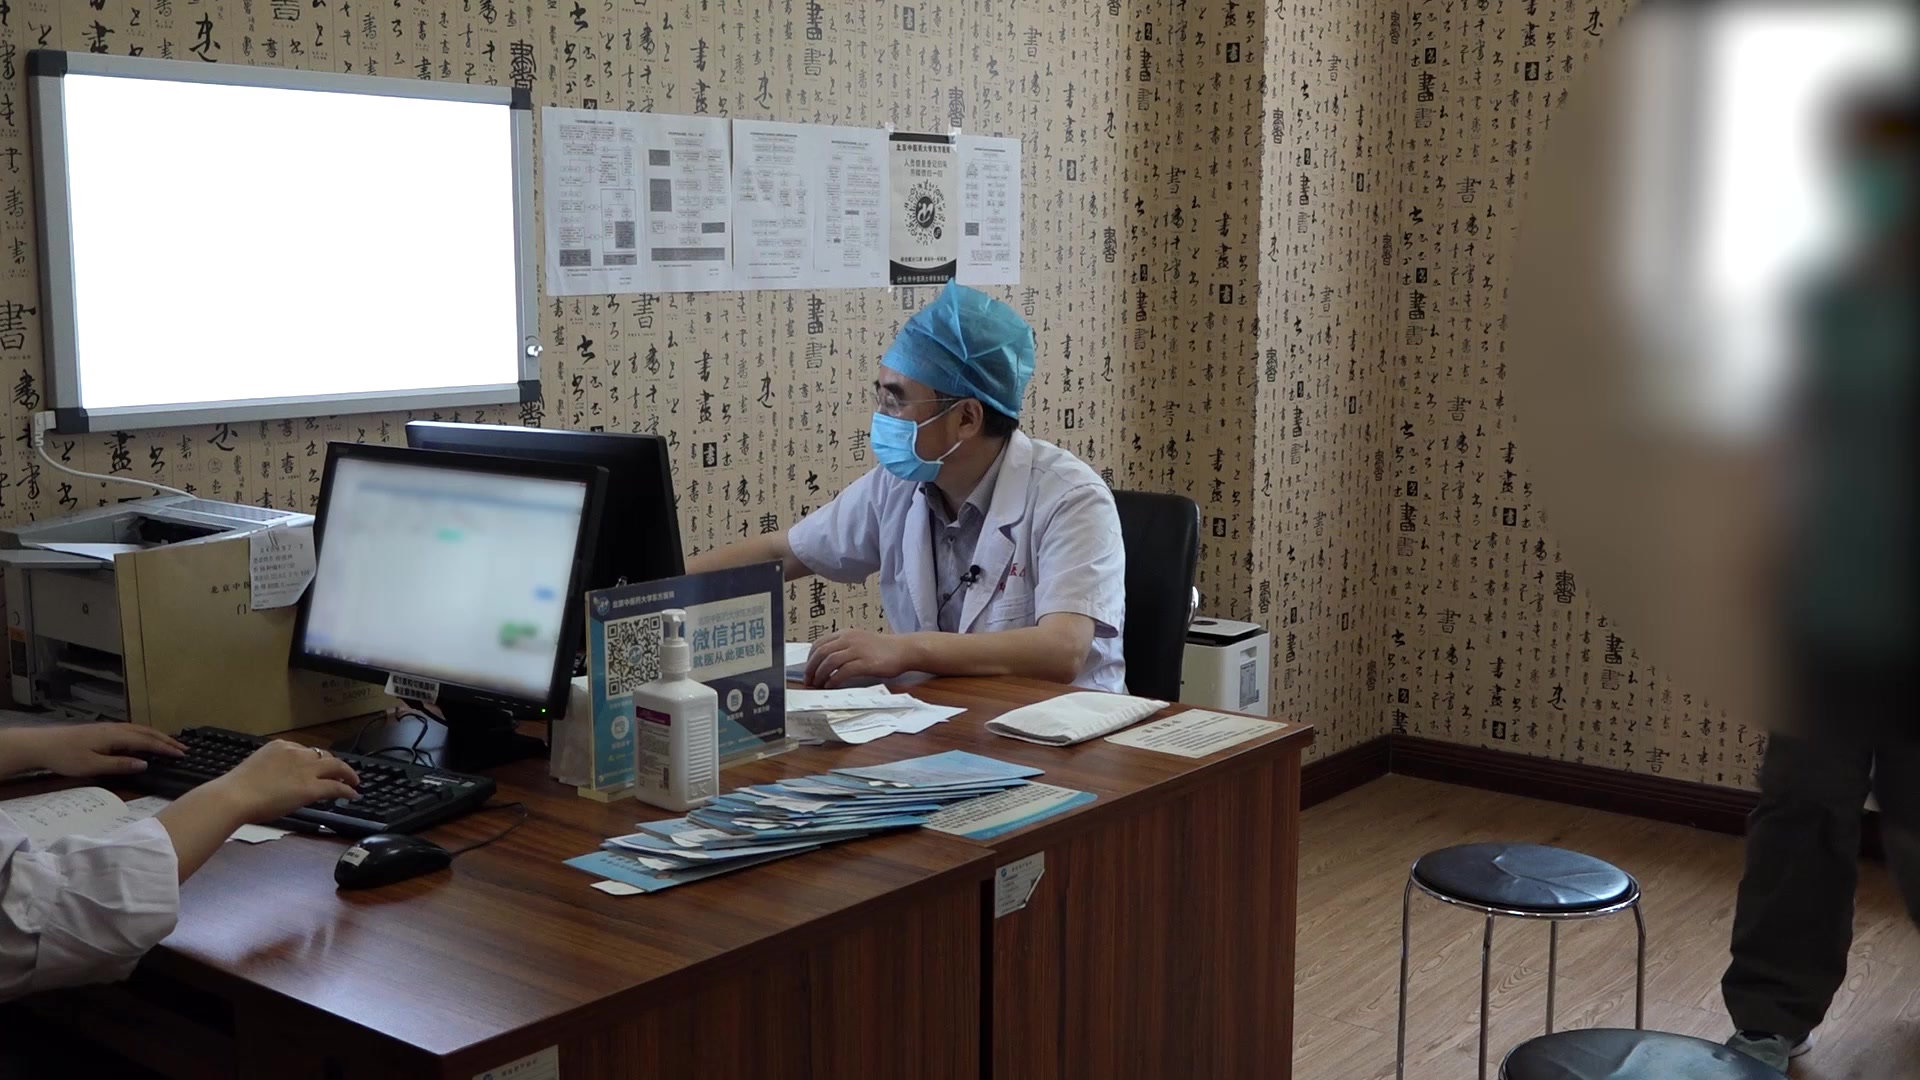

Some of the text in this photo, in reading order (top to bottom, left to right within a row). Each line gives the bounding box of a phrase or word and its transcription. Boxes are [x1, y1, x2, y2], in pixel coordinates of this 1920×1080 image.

[692, 618, 765, 653] 微信扫码
[693, 642, 765, 668] 就医从此更轻松
